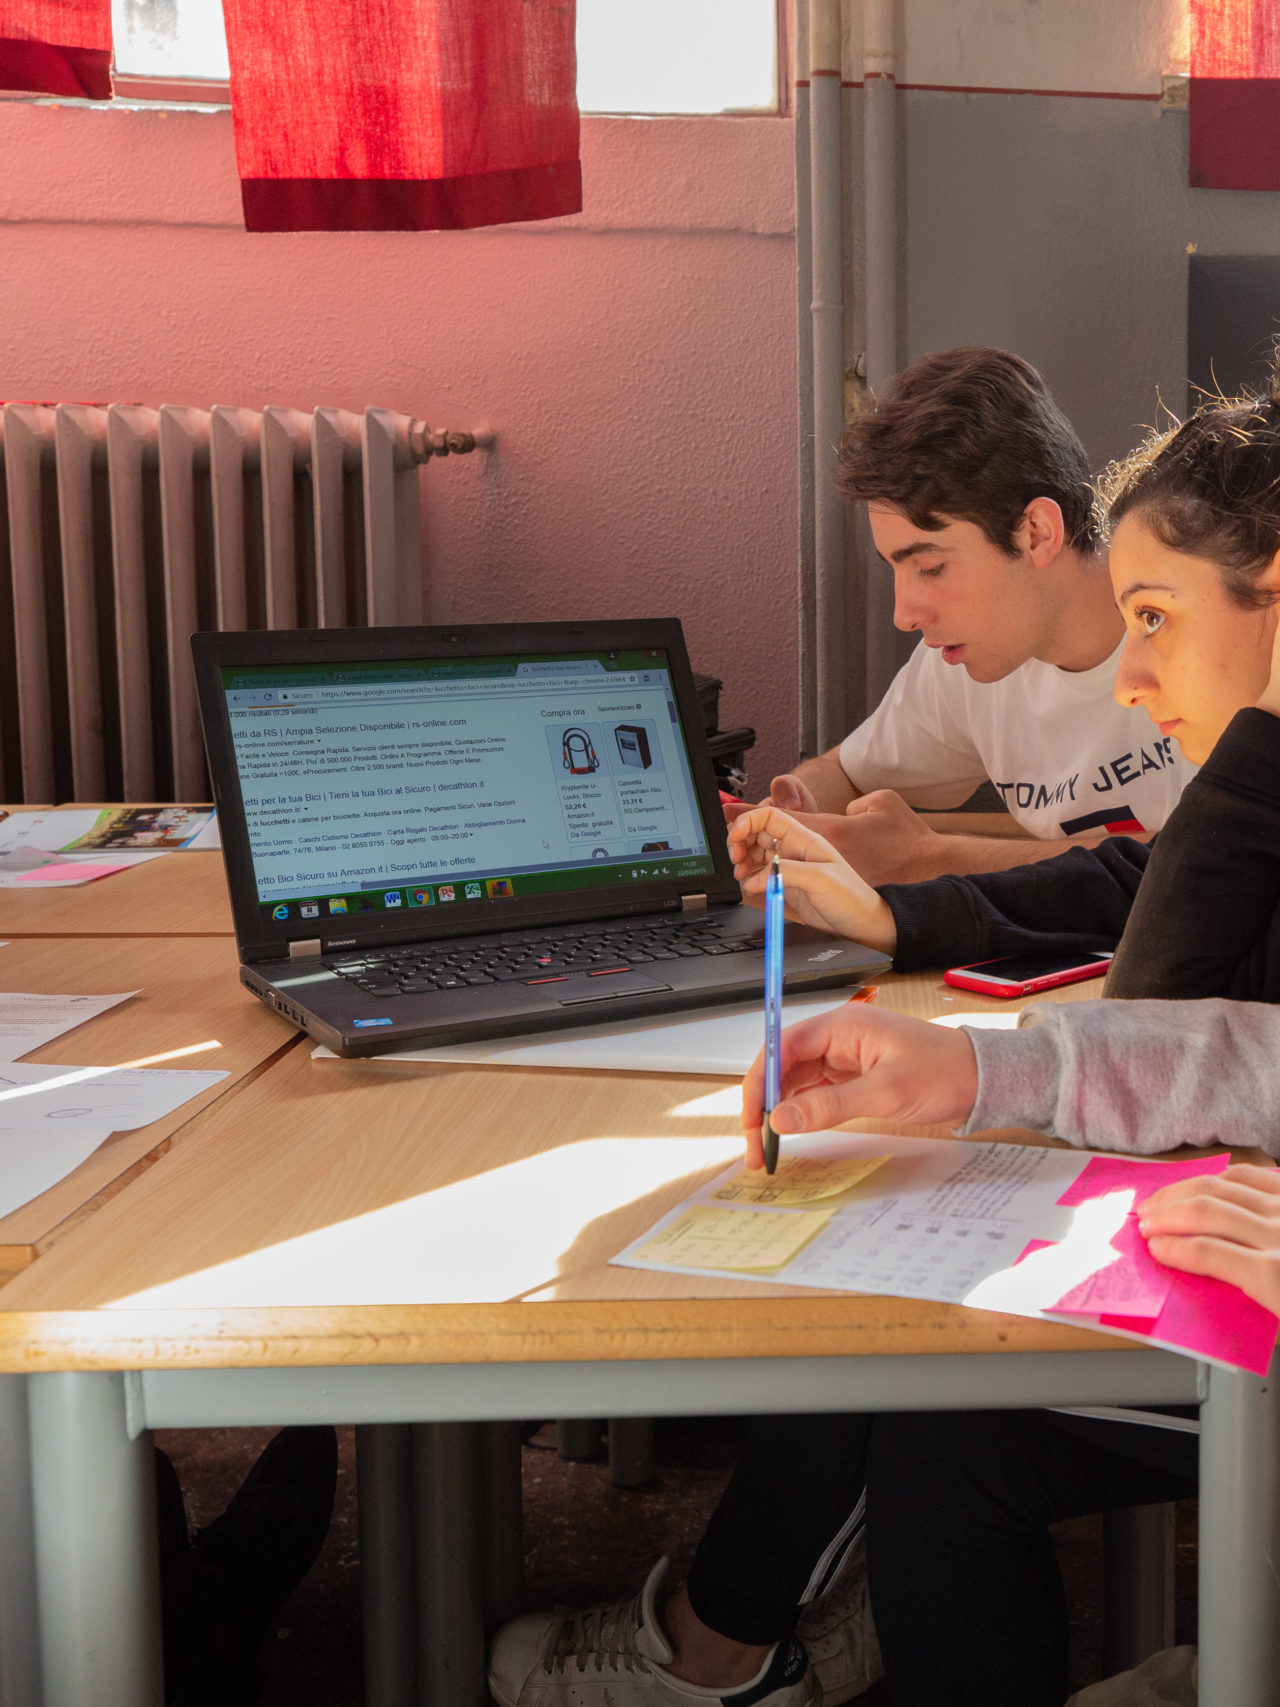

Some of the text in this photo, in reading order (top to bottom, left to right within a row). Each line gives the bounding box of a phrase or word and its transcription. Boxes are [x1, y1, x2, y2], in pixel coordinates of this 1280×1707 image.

[540, 709, 571, 718] Compra
[264, 729, 277, 737] RS
[285, 727, 313, 737] Ampia
[315, 724, 357, 734] Selezione
[359, 721, 405, 732] Disponibile
[412, 718, 467, 728] rs-online.com
[260, 796, 275, 806] per
[278, 795, 286, 803] la
[288, 794, 302, 802] tua
[305, 793, 320, 801] Bici
[330, 790, 349, 799] Tieni
[351, 790, 359, 798] la
[362, 788, 375, 797] tua
[377, 787, 393, 796] Bici
[394, 786, 402, 794] al
[404, 784, 431, 793] Sicuro
[437, 780, 484, 791] decathlon.it
[996, 773, 1079, 809] TOMMY
[277, 873, 294, 883] Bici
[296, 870, 324, 881] Sicuro
[327, 869, 338, 878] su
[339, 865, 383, 876] Amazon.it
[390, 861, 418, 872] Scopri
[419, 859, 437, 868] tutte
[449, 856, 476, 865] offerte
[327, 939, 356, 947] lenovo
